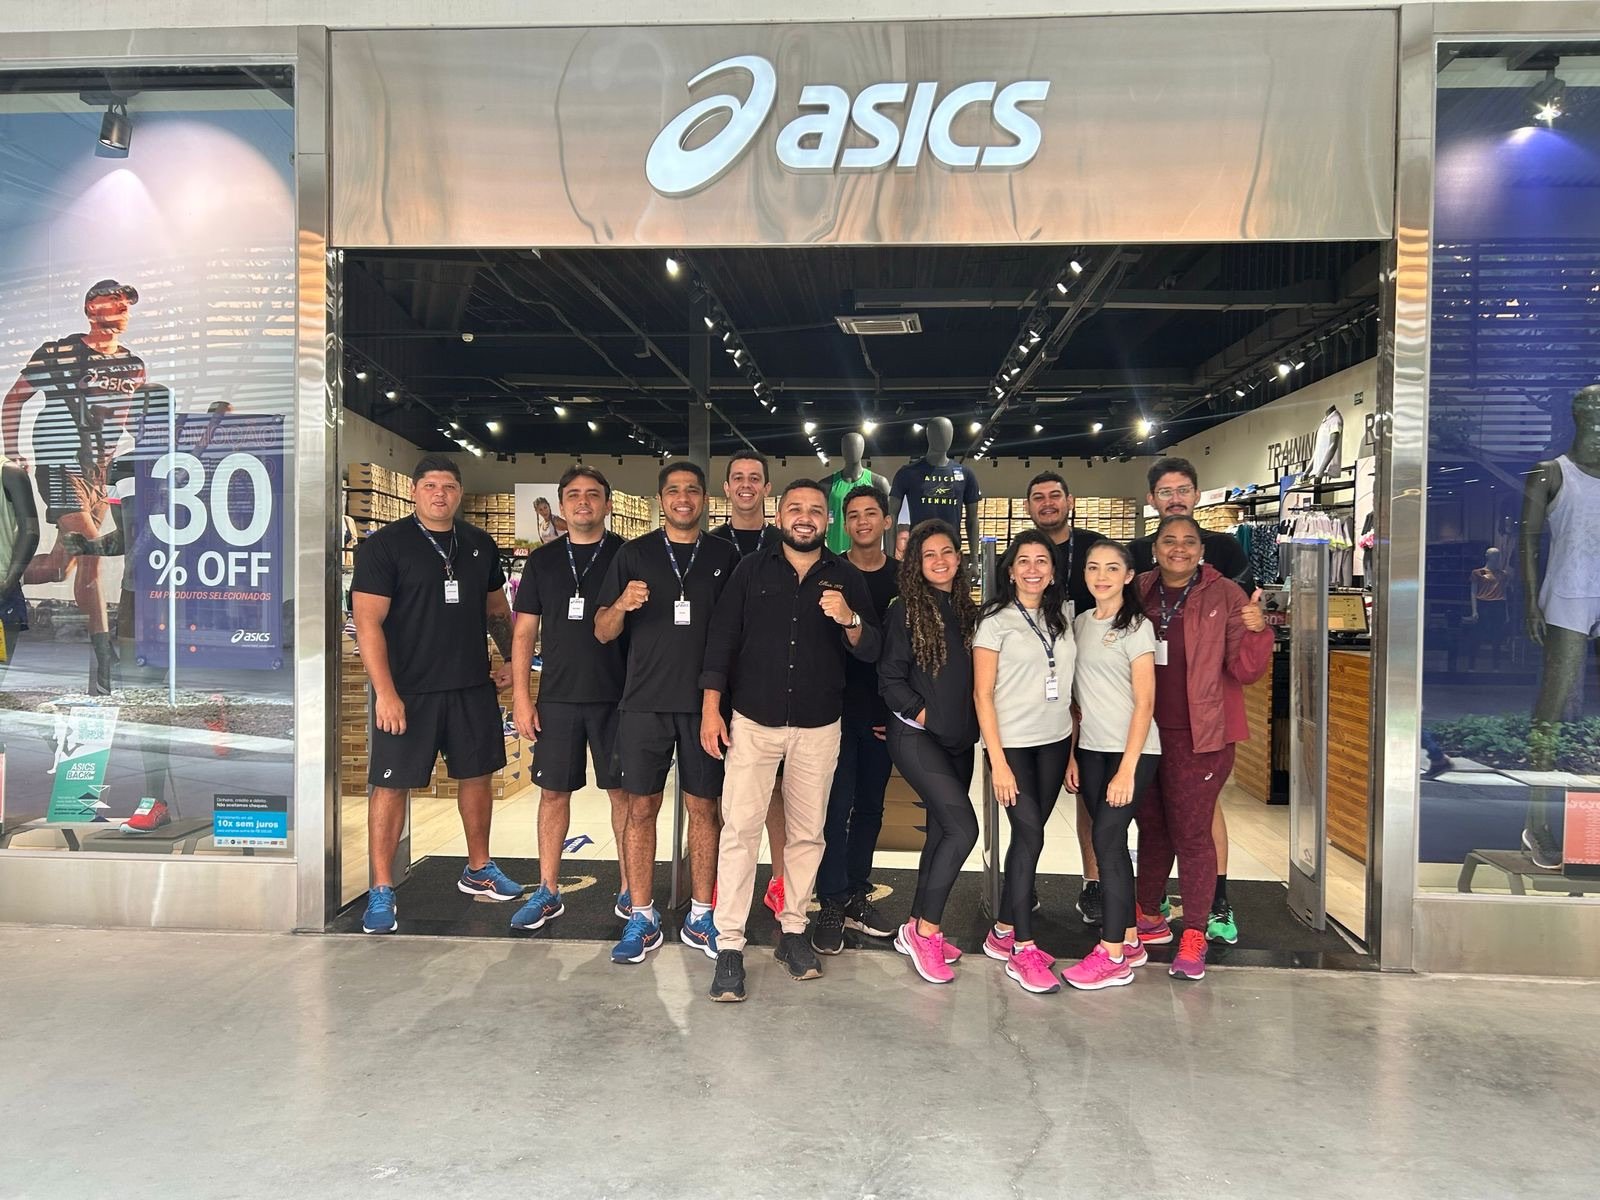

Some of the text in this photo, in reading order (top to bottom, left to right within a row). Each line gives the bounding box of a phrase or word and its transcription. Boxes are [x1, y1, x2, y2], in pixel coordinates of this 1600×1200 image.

[776, 80, 1051, 172] asics
[149, 452, 273, 546] 30
[921, 497, 957, 505] TENNIS
[197, 551, 272, 587] OFF
[149, 590, 271, 601] EM PODUTOS SELECIONADOS
[243, 632, 271, 642] asics
[70, 763, 96, 771] ASICS
[256, 819, 279, 829] juros
